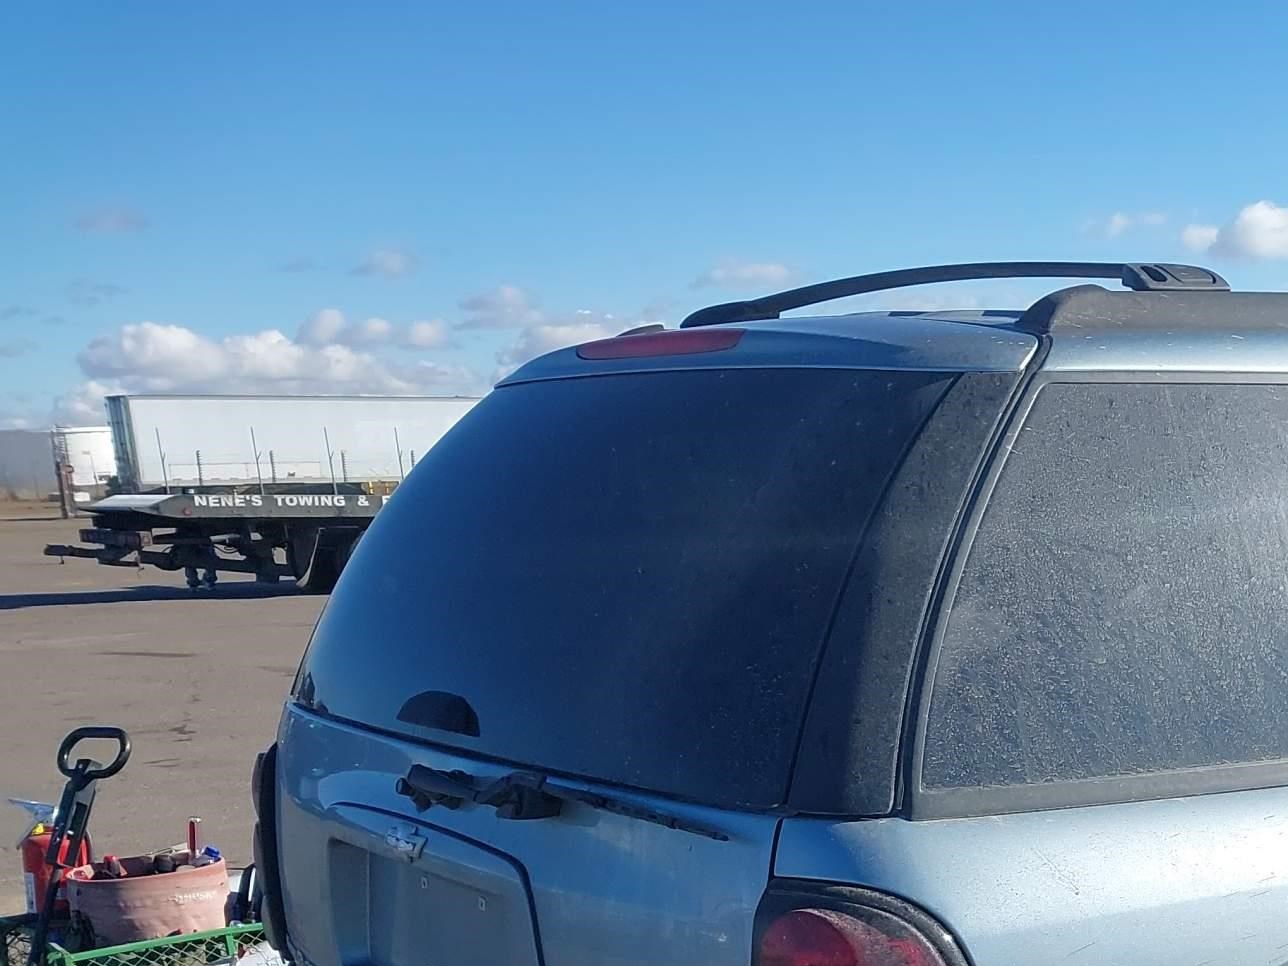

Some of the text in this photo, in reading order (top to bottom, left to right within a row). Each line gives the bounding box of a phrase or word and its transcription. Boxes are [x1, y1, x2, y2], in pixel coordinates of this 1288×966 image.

[193, 495, 263, 507] NENE'S
[274, 495, 347, 507] TOWING
[357, 495, 370, 507] &
